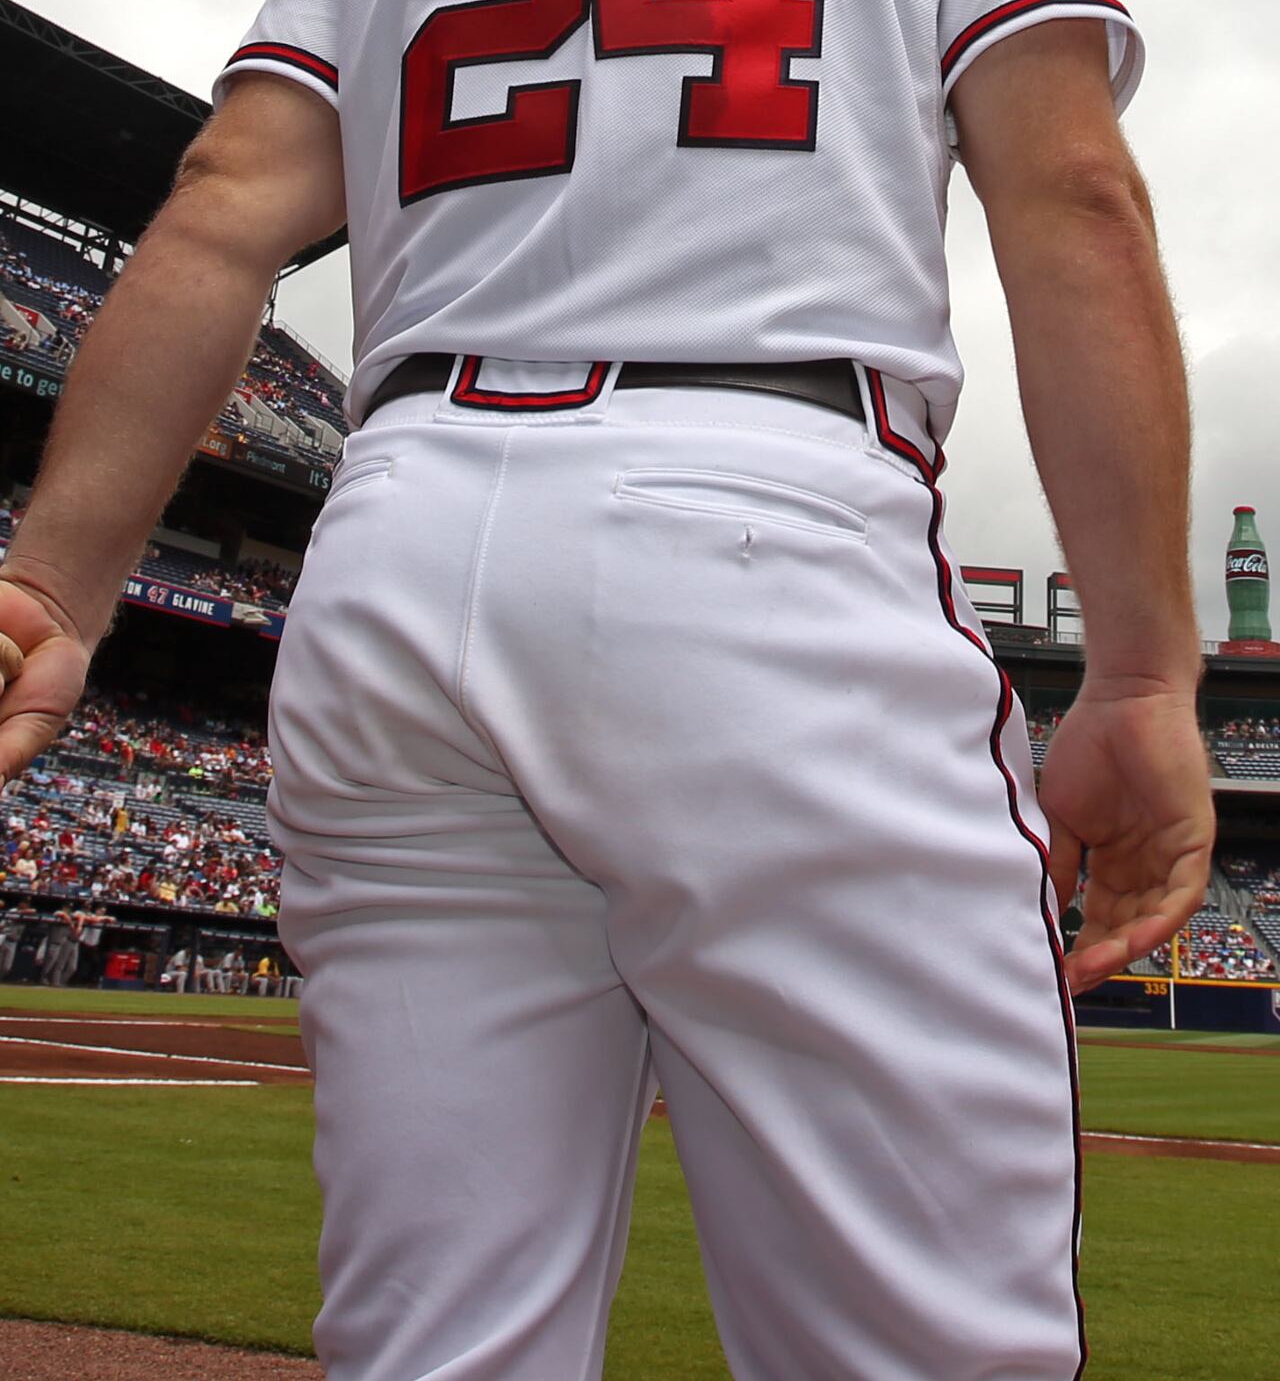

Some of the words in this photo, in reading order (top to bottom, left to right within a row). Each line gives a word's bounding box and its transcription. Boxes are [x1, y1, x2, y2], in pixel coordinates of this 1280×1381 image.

[17, 368, 35, 388] to
[246, 450, 286, 474] Piedmont
[309, 469, 330, 489] It's
[146, 585, 169, 606] 47
[172, 593, 216, 616] GLAVINE
[1254, 742, 1279, 750] DELTA
[1144, 982, 1168, 996] 335
